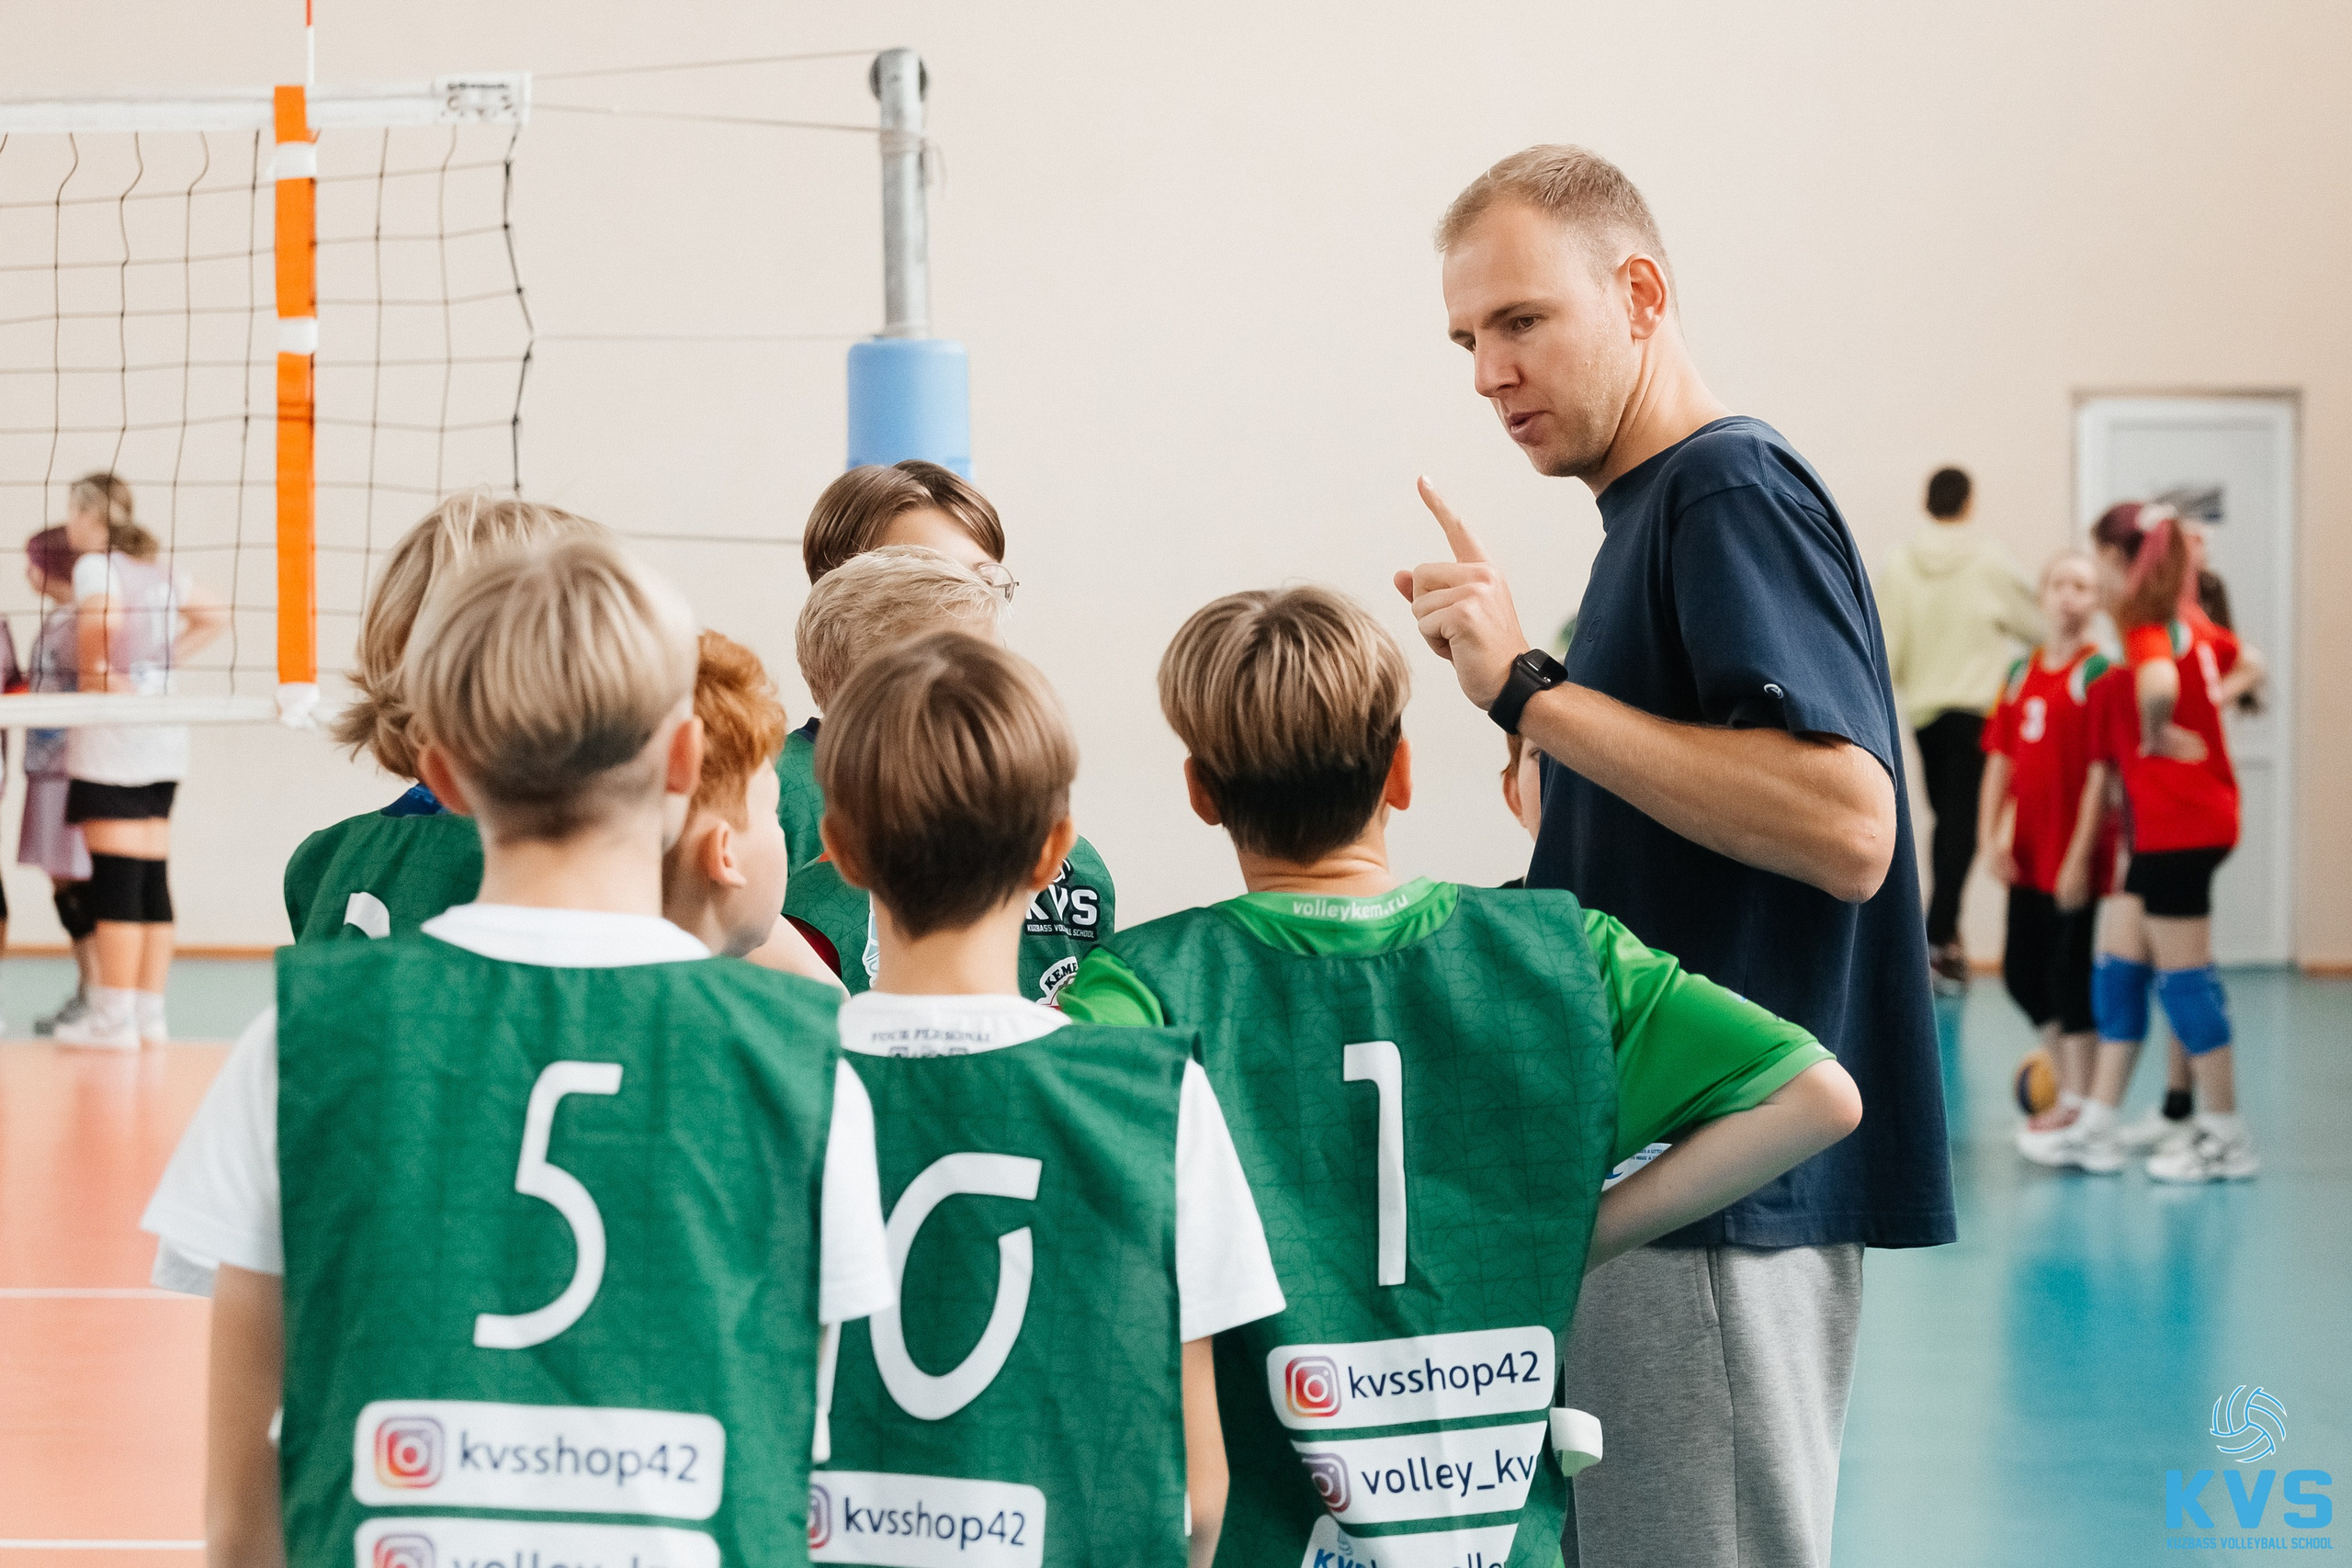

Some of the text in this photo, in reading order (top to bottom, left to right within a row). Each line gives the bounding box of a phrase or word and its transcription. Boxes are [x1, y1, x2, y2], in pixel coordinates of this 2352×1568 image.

[1025, 884, 1098, 925] KVS
[1292, 894, 1408, 921] volleykem.ru
[1343, 1041, 1407, 1286] 1
[473, 1061, 624, 1349] 5
[1348, 1350, 1541, 1399] kvsshop42
[461, 1430, 698, 1487] kvsshop42
[1361, 1449, 1534, 1497] volley_kv
[844, 1496, 1025, 1551] kvsshop42
